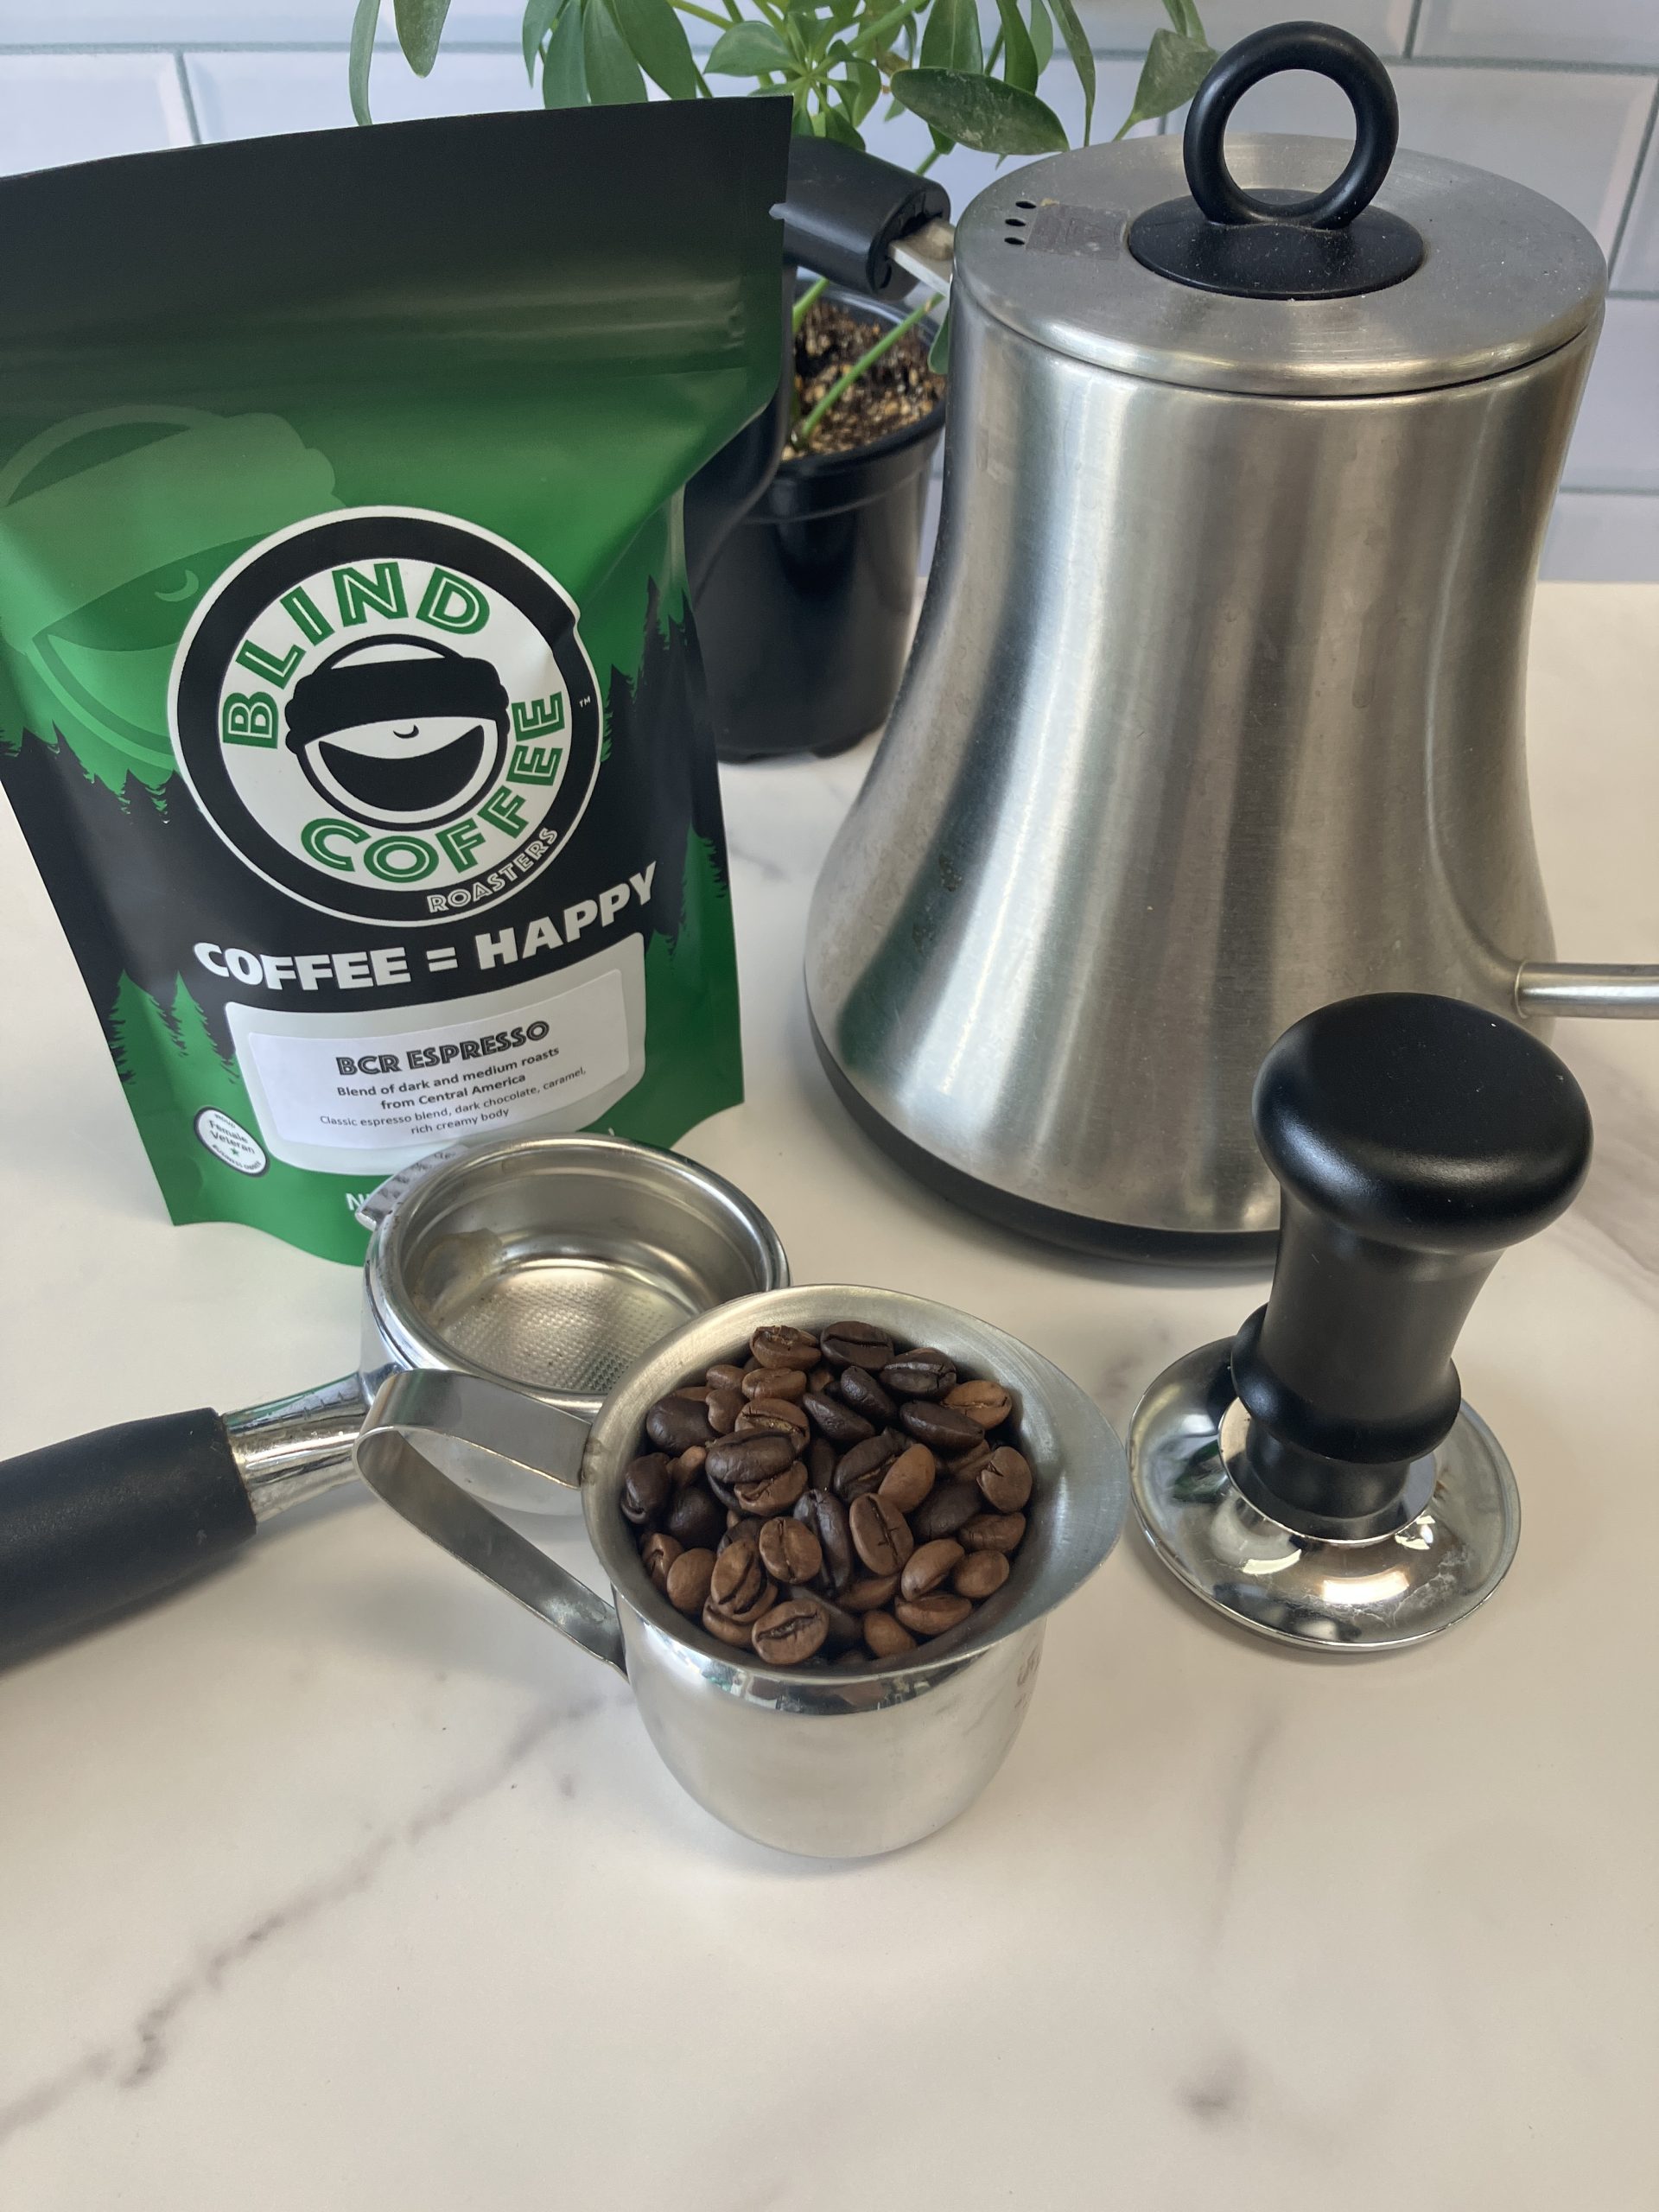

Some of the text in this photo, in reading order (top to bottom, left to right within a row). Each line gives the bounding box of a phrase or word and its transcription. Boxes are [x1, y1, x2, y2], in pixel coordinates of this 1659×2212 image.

[222, 562, 490, 749] BLIND
[301, 691, 565, 883] COFFEE
[427, 827, 558, 913] ROASTERS
[194, 942, 411, 990] COFFEE
[474, 861, 657, 970] HAPPY
[335, 1020, 550, 1076] BCR ESPRESSO
[337, 1046, 560, 1096] Blend of dark and medium roasts
[320, 1066, 587, 1128] Classic espresso blend, dark chocolate, caramel,
[380, 1074, 526, 1110] from Central America
[410, 1108, 510, 1135] rich creamy body
